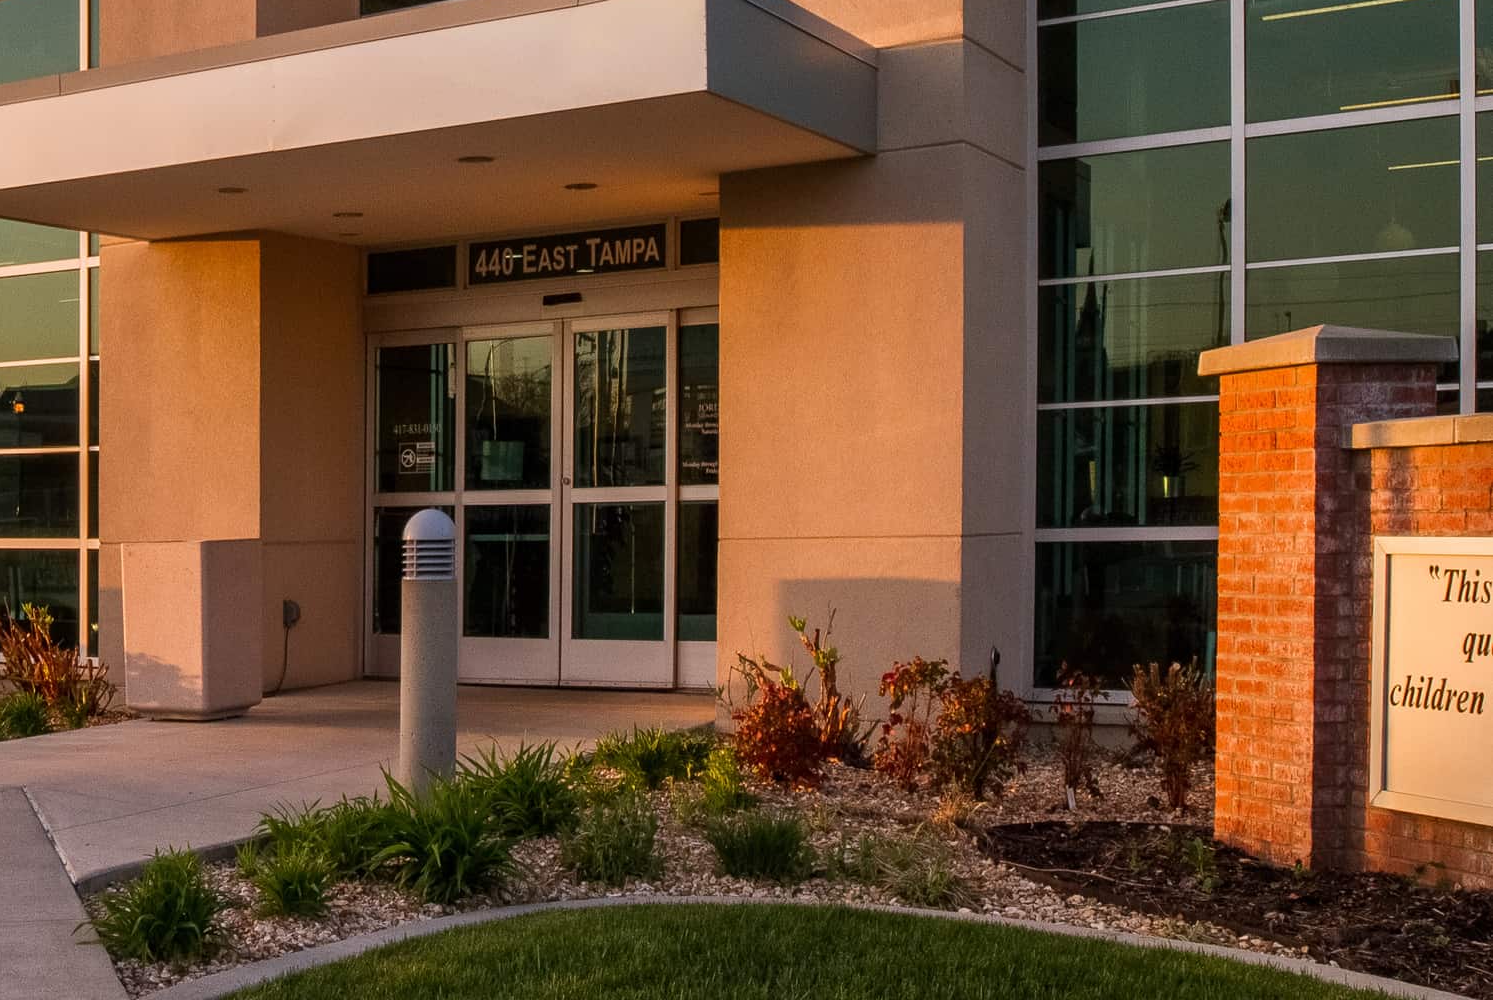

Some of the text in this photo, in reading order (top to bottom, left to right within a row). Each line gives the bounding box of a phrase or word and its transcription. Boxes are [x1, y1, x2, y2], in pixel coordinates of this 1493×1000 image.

[522, 244, 579, 274] EAST
[586, 237, 660, 268] TAMPA
[1463, 631, 1493, 664] qu
[1389, 674, 1485, 715] children
